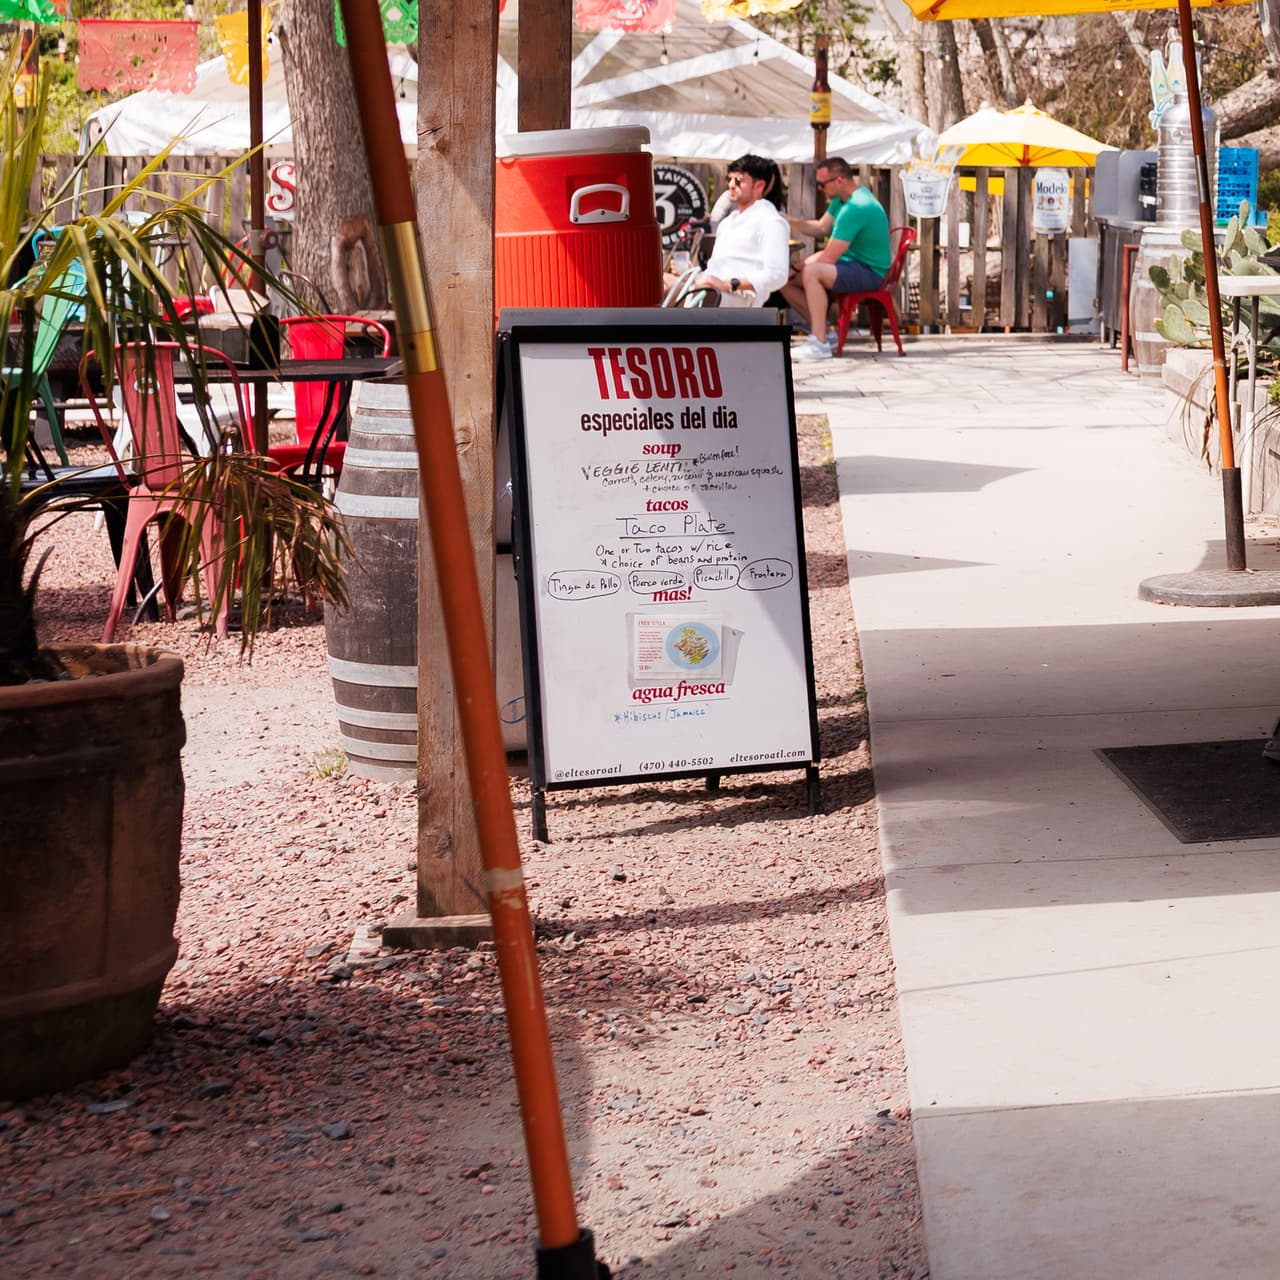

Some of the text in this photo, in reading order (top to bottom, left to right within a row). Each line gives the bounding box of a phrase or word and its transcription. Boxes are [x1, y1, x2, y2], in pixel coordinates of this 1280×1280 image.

[587, 346, 723, 400] TESORO
[581, 406, 738, 436] especiales del dia
[642, 443, 681, 458] soup
[581, 461, 641, 480] VEGGIE
[646, 498, 689, 512] tacos
[616, 512, 727, 535] Taco Plate
[595, 544, 614, 556] One
[655, 542, 683, 553] tacos
[706, 542, 733, 552] rice
[611, 557, 643, 569] choice
[667, 555, 695, 565] beans
[652, 586, 692, 602] mas!
[632, 680, 725, 703] agua fresca
[555, 748, 806, 779] @eltesoroatl (470) 440-5502 eltesoroatl.com
